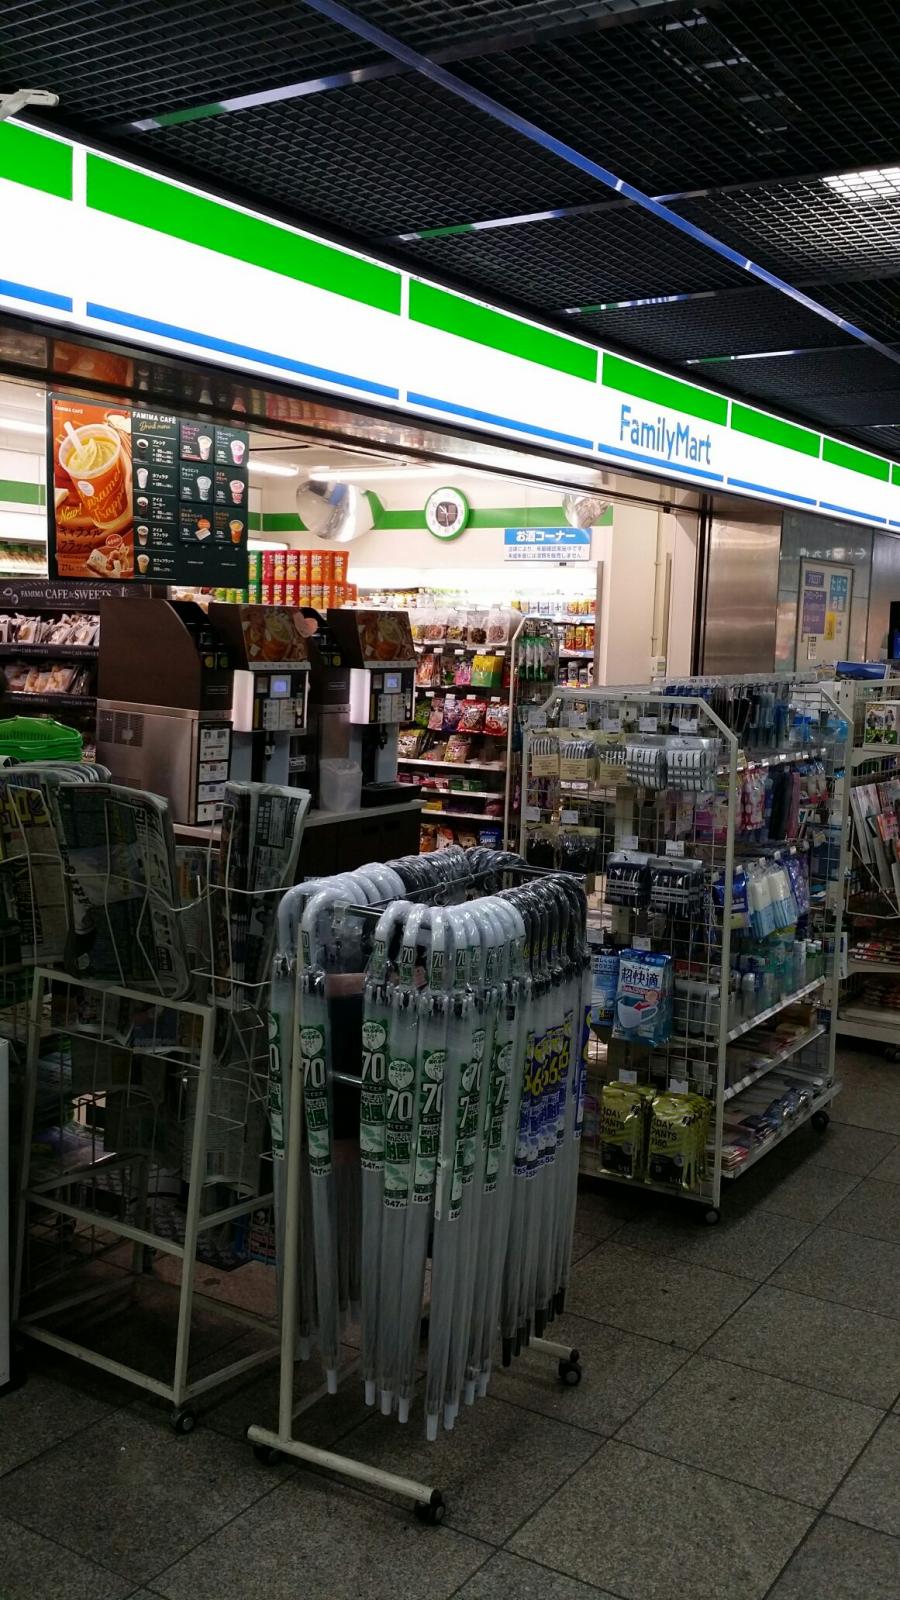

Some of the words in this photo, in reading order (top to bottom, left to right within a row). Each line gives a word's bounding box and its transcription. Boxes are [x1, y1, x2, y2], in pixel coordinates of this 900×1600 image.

[132, 411, 158, 420] FAMIMA
[620, 404, 711, 465] FamilyMart
[516, 530, 576, 542] お酒コーナー
[20, 590, 44, 598] FAMIMA
[45, 588, 69, 599] CAFE
[403, 947, 414, 963] 70
[433, 952, 445, 968] 70
[621, 967, 660, 989] 超快適
[269, 1042, 280, 1073] 0
[361, 1051, 386, 1083] 70
[301, 1057, 326, 1088] 70
[386, 1088, 413, 1121] 70
